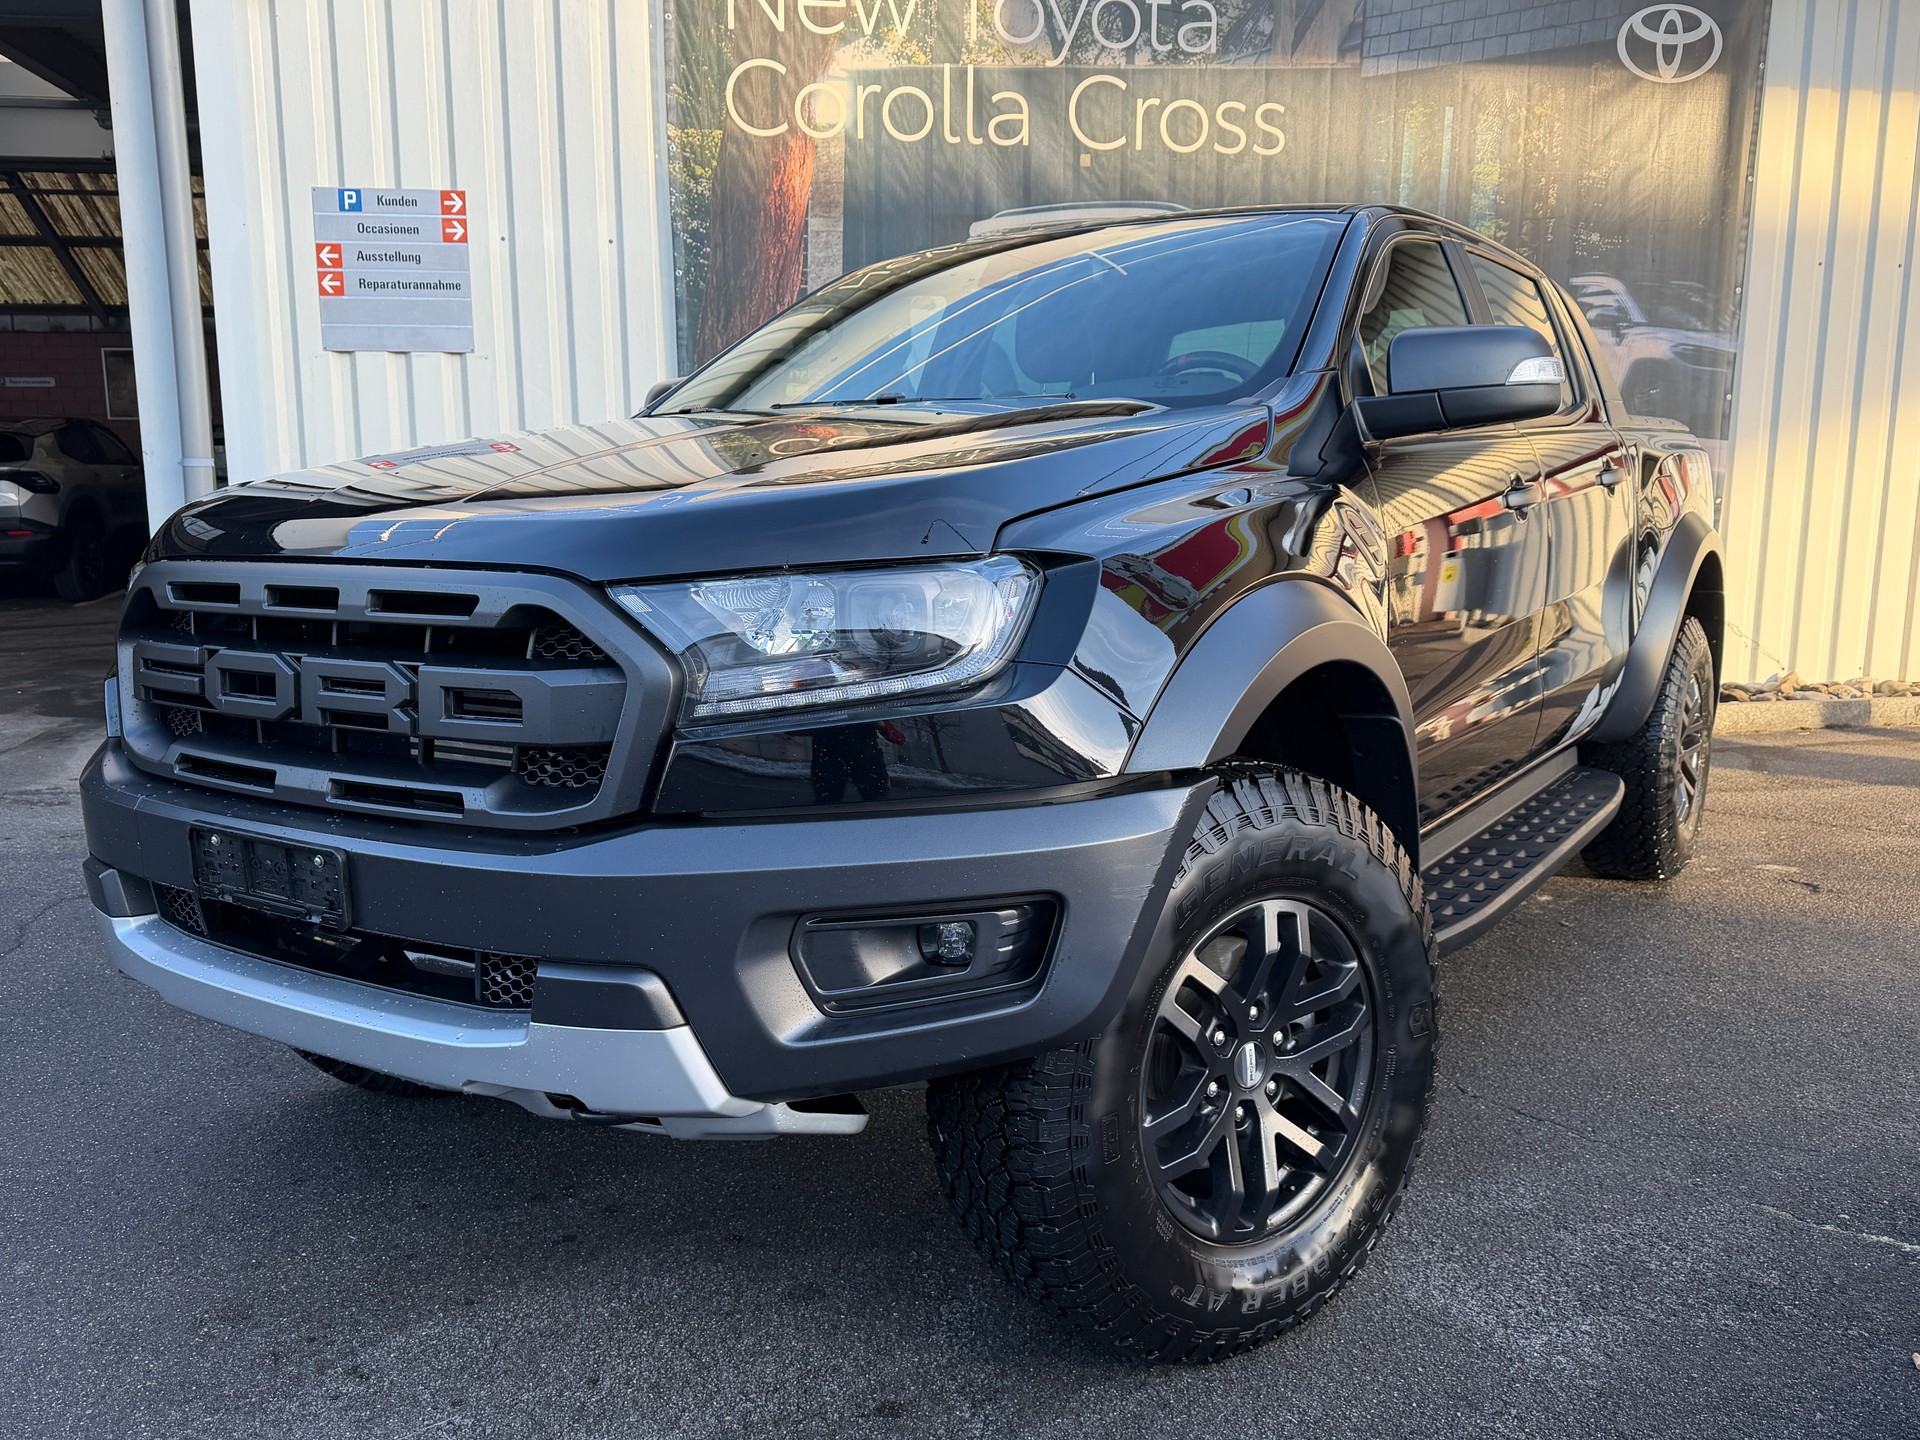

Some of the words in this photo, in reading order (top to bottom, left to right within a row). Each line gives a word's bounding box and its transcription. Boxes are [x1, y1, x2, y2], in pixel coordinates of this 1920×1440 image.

[726, 58, 1029, 146] Corolla
[1069, 74, 1286, 155] Cross
[344, 191, 357, 210] P
[376, 195, 418, 207] Kunden
[357, 222, 420, 235] Occasionen
[356, 250, 421, 265] Ausstellung
[358, 278, 462, 292] Reparaturannahme
[133, 640, 622, 747] FORD
[1174, 834, 1359, 929] GENERAL
